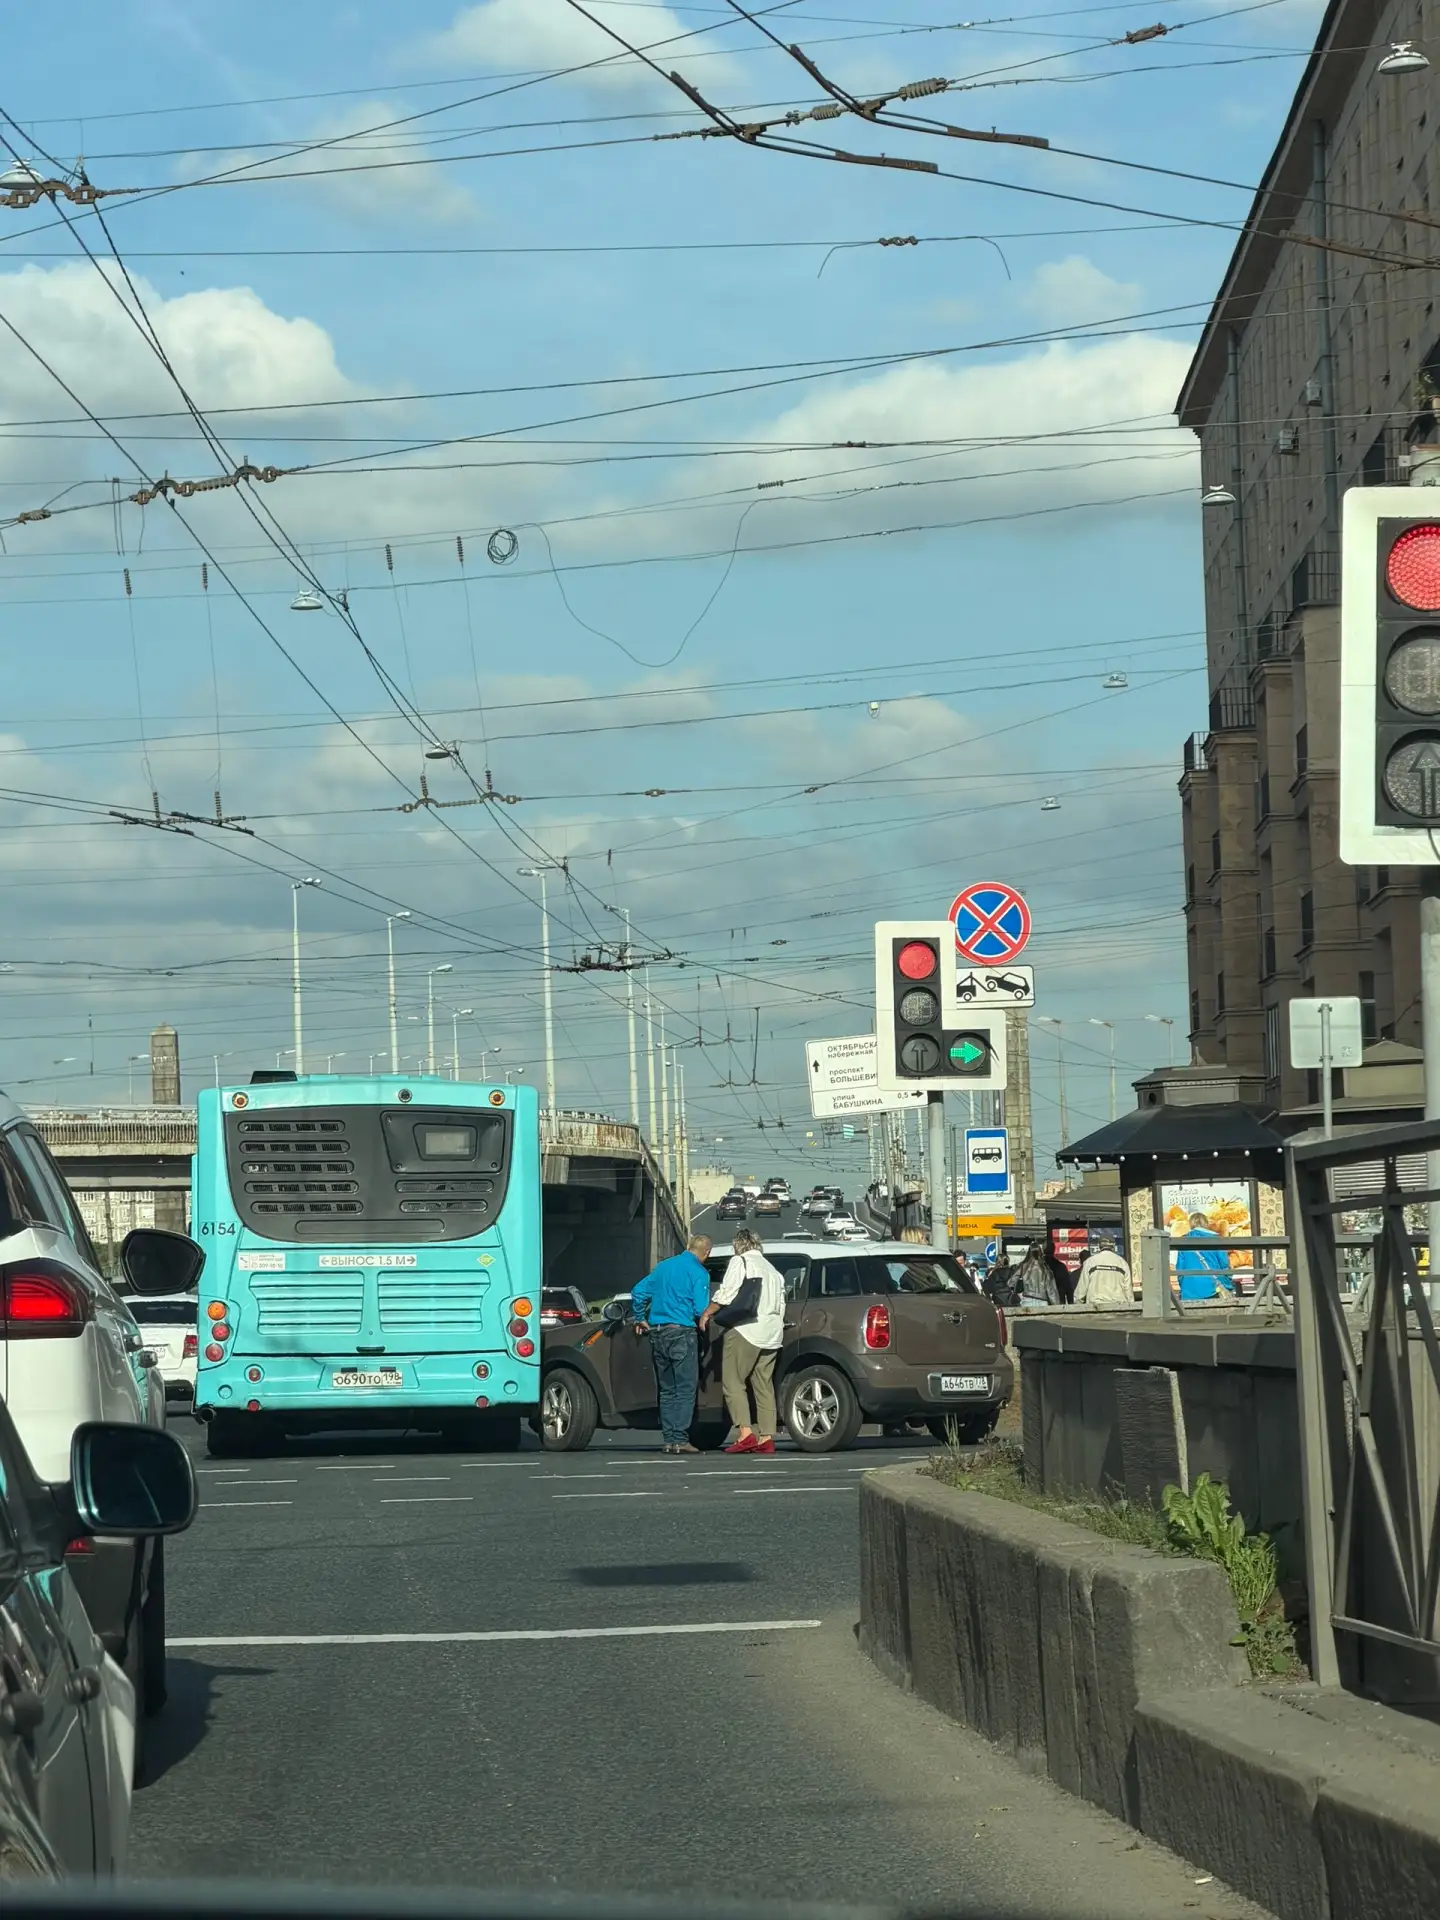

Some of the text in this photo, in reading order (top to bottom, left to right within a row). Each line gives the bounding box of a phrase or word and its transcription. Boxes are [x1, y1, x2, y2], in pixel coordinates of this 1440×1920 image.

[827, 1049, 874, 1059] набережная
[829, 1067, 864, 1076] проспект
[832, 1094, 855, 1103] улица
[833, 1098, 883, 1109] БАБУШКИНА
[201, 1222, 236, 1236] 6154
[331, 1255, 406, 1266] ВЫНОС 1.5 М
